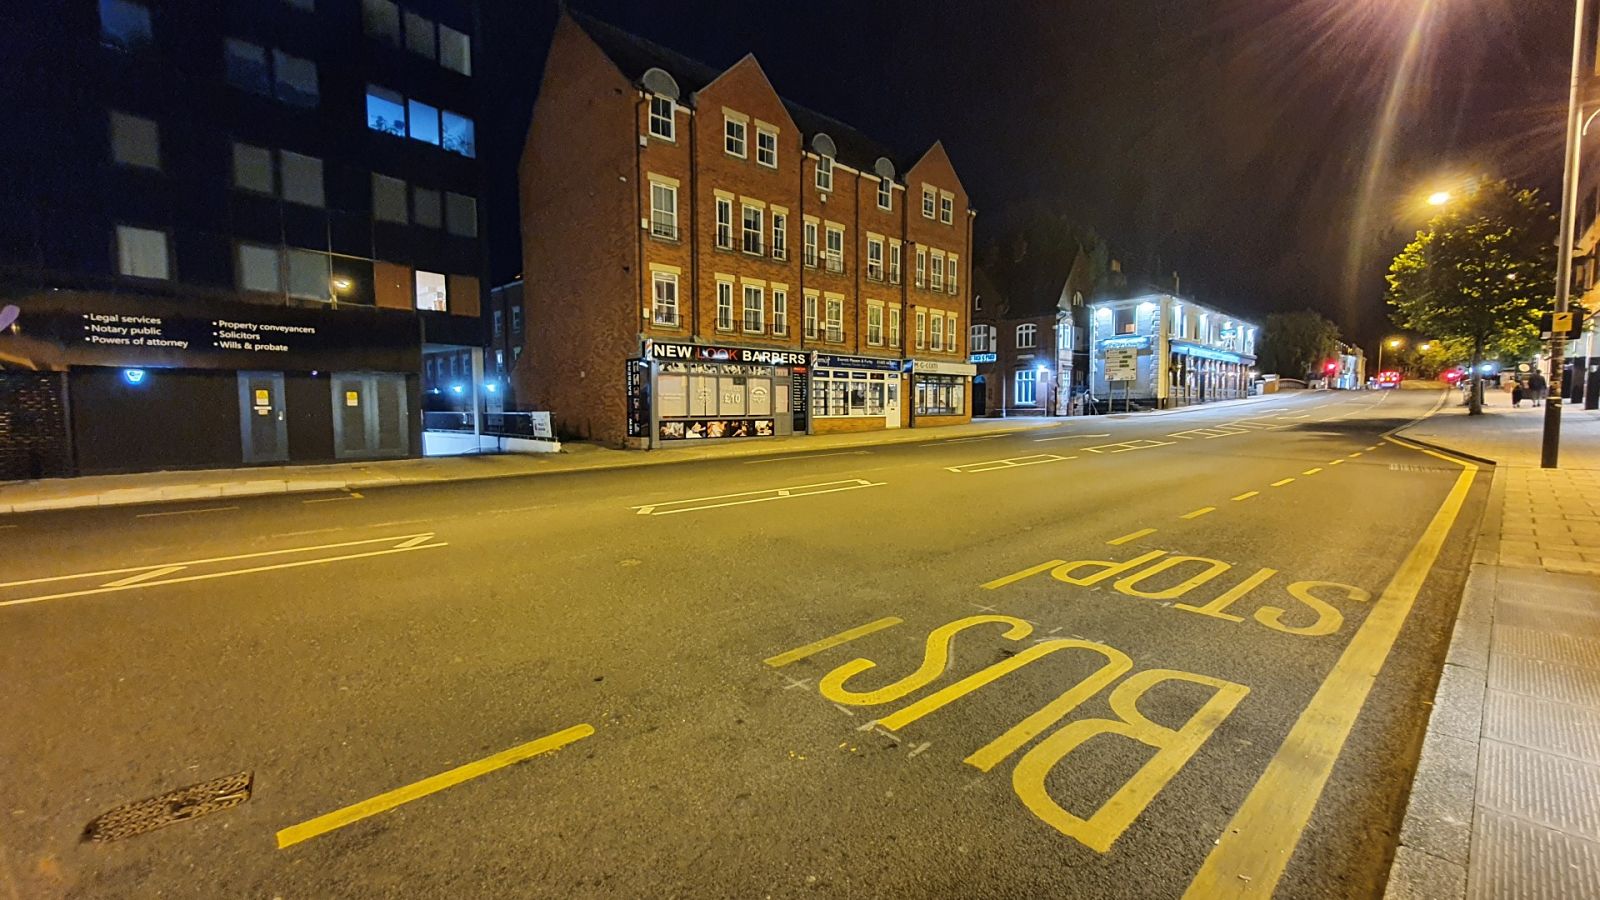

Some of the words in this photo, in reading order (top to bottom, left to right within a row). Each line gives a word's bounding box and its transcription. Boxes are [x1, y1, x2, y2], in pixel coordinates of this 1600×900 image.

[90, 313, 119, 324] Legal
[121, 315, 162, 325] services
[91, 324, 127, 335] Notary
[130, 326, 162, 336] public
[218, 319, 258, 331] Property
[259, 323, 316, 334] conveyancers
[219, 330, 261, 340] Solicitors
[91, 335, 130, 345] Powers
[132, 336, 144, 345] of
[146, 338, 189, 349] attorney
[219, 340, 242, 349] Wills
[243, 342, 253, 350] &
[254, 343, 289, 352] probate
[653, 344, 692, 359] NEW
[696, 347, 738, 361] LOOK
[742, 349, 806, 365] BARBERS
[723, 393, 741, 404] £10
[1050, 549, 1369, 636] STOP
[818, 614, 1251, 853] BUS
